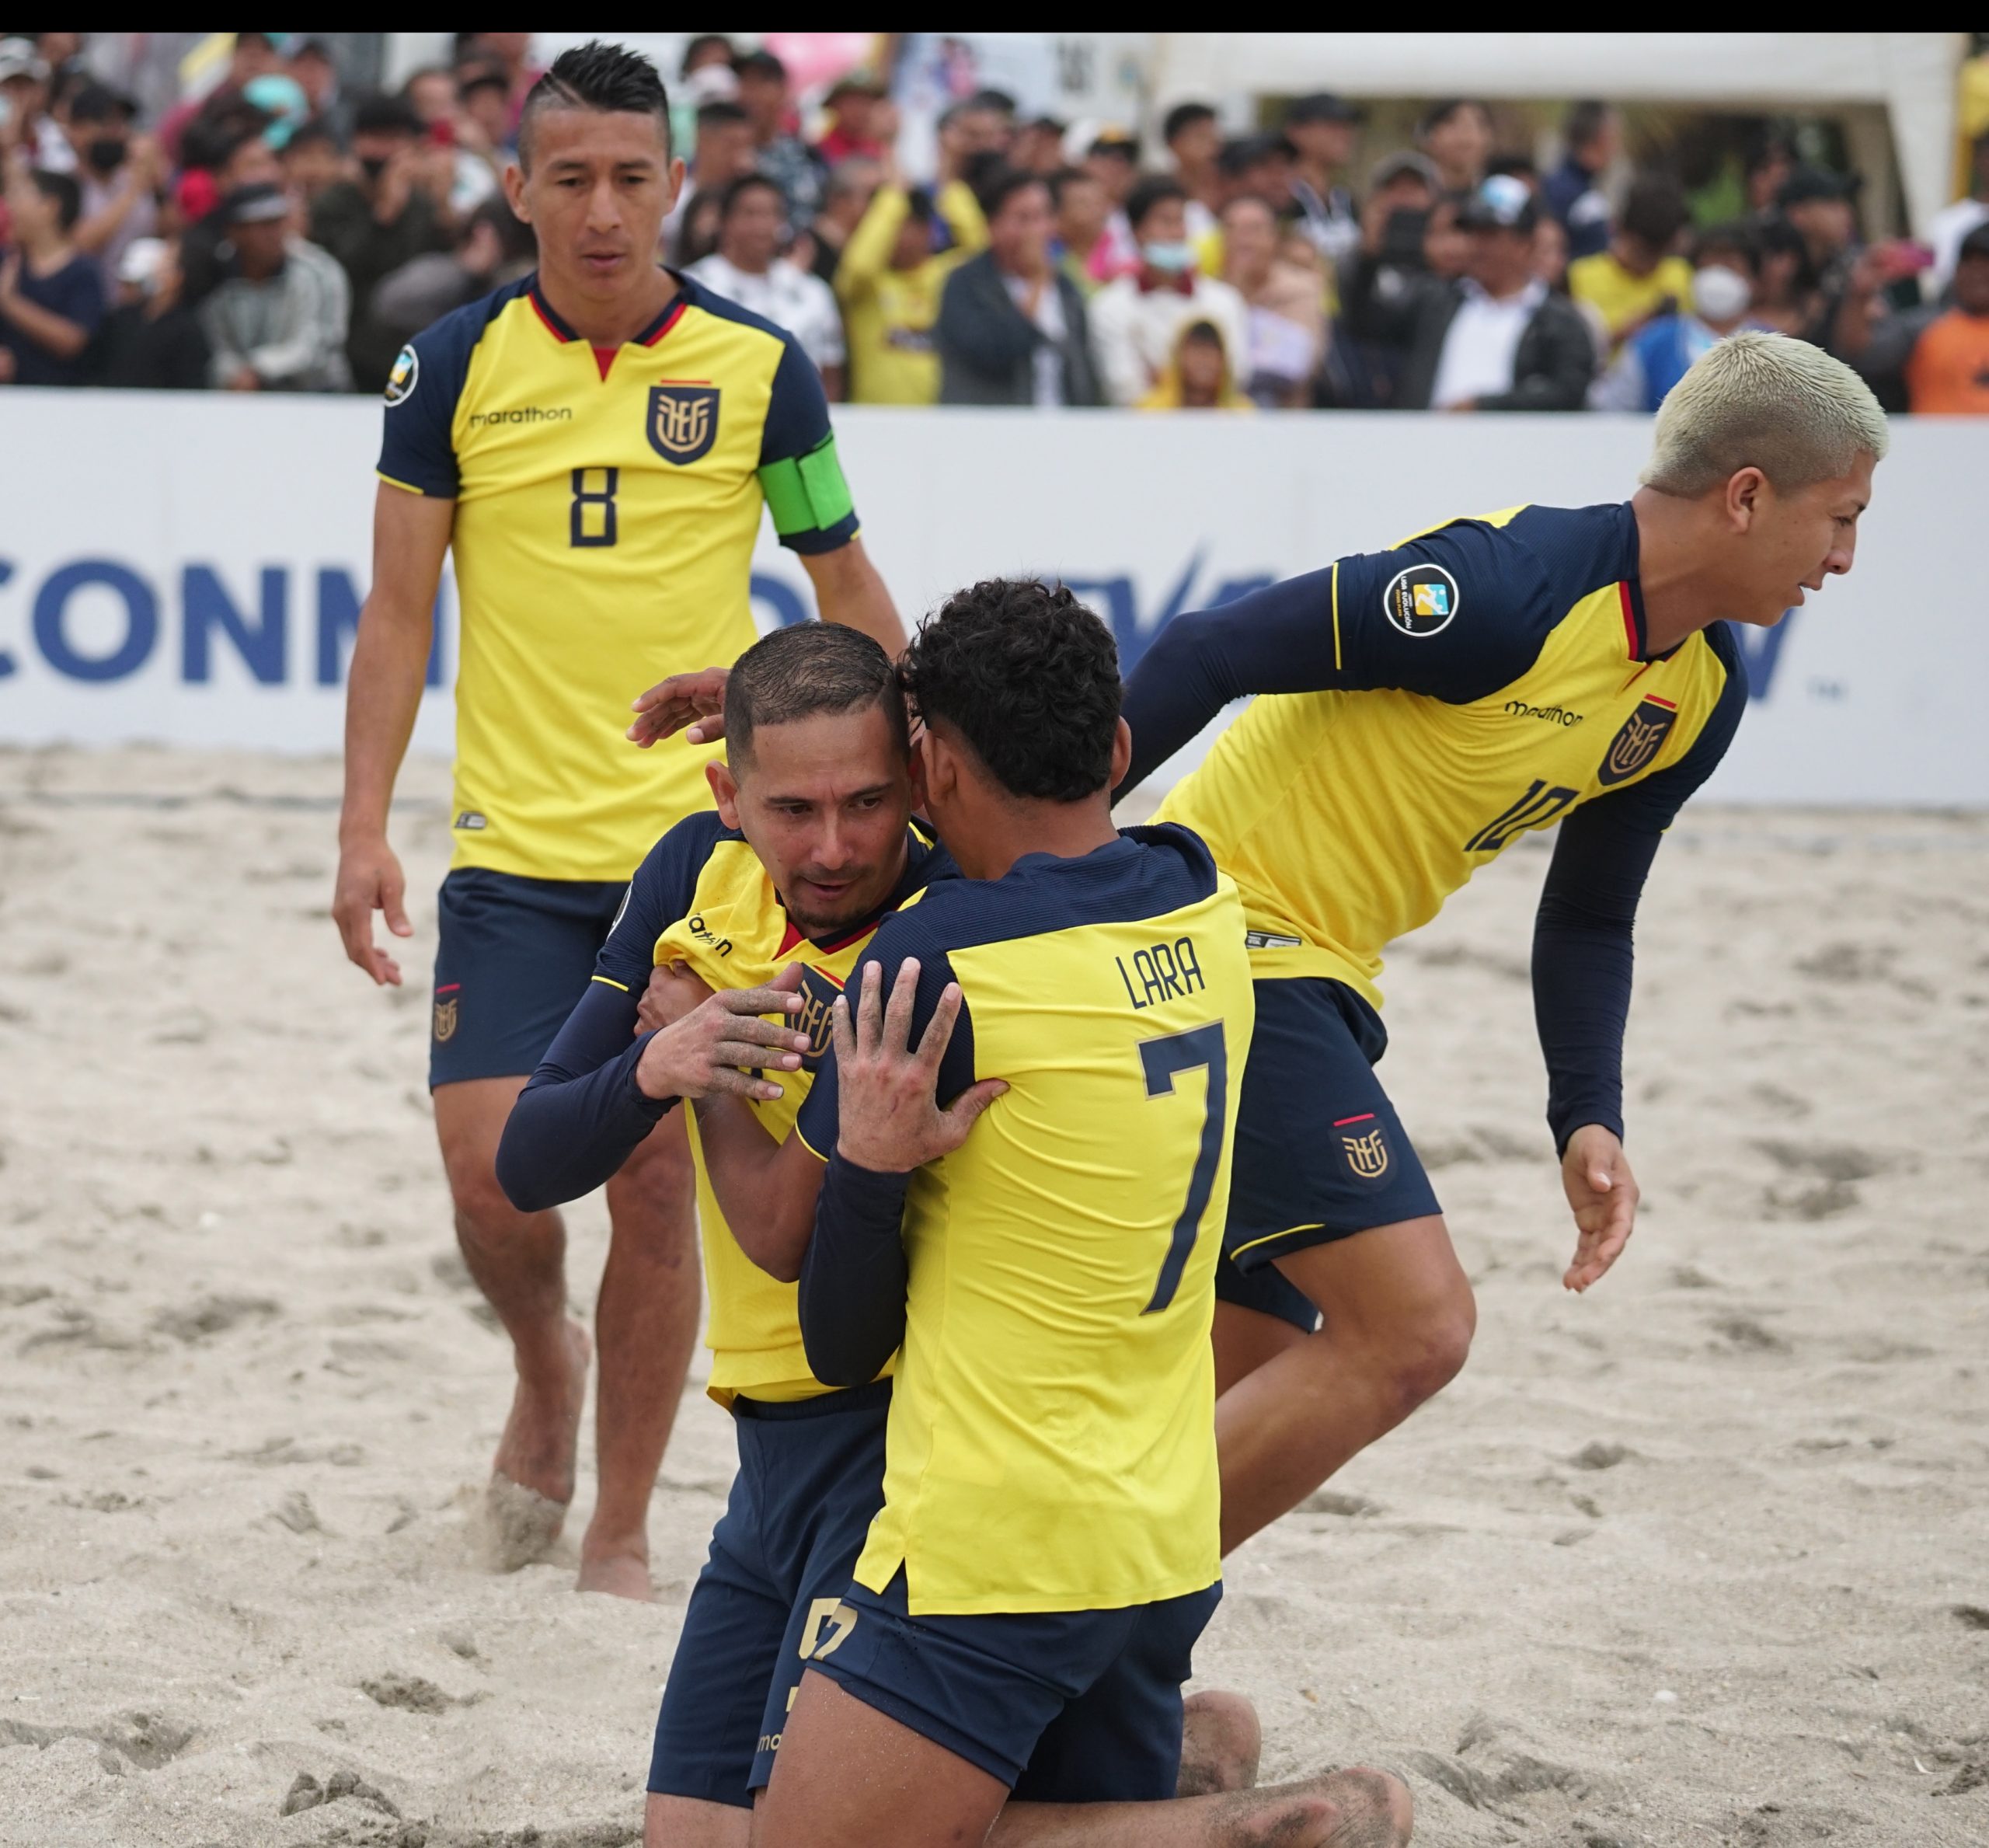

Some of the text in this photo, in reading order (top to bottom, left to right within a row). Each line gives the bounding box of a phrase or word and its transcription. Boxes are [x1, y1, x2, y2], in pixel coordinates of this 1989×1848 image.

[469, 406, 573, 428] marathon
[569, 466, 618, 547] 8
[1463, 778, 1581, 852] 10
[1115, 936, 1206, 1009] LARA
[1134, 1017, 1228, 1316] 7
